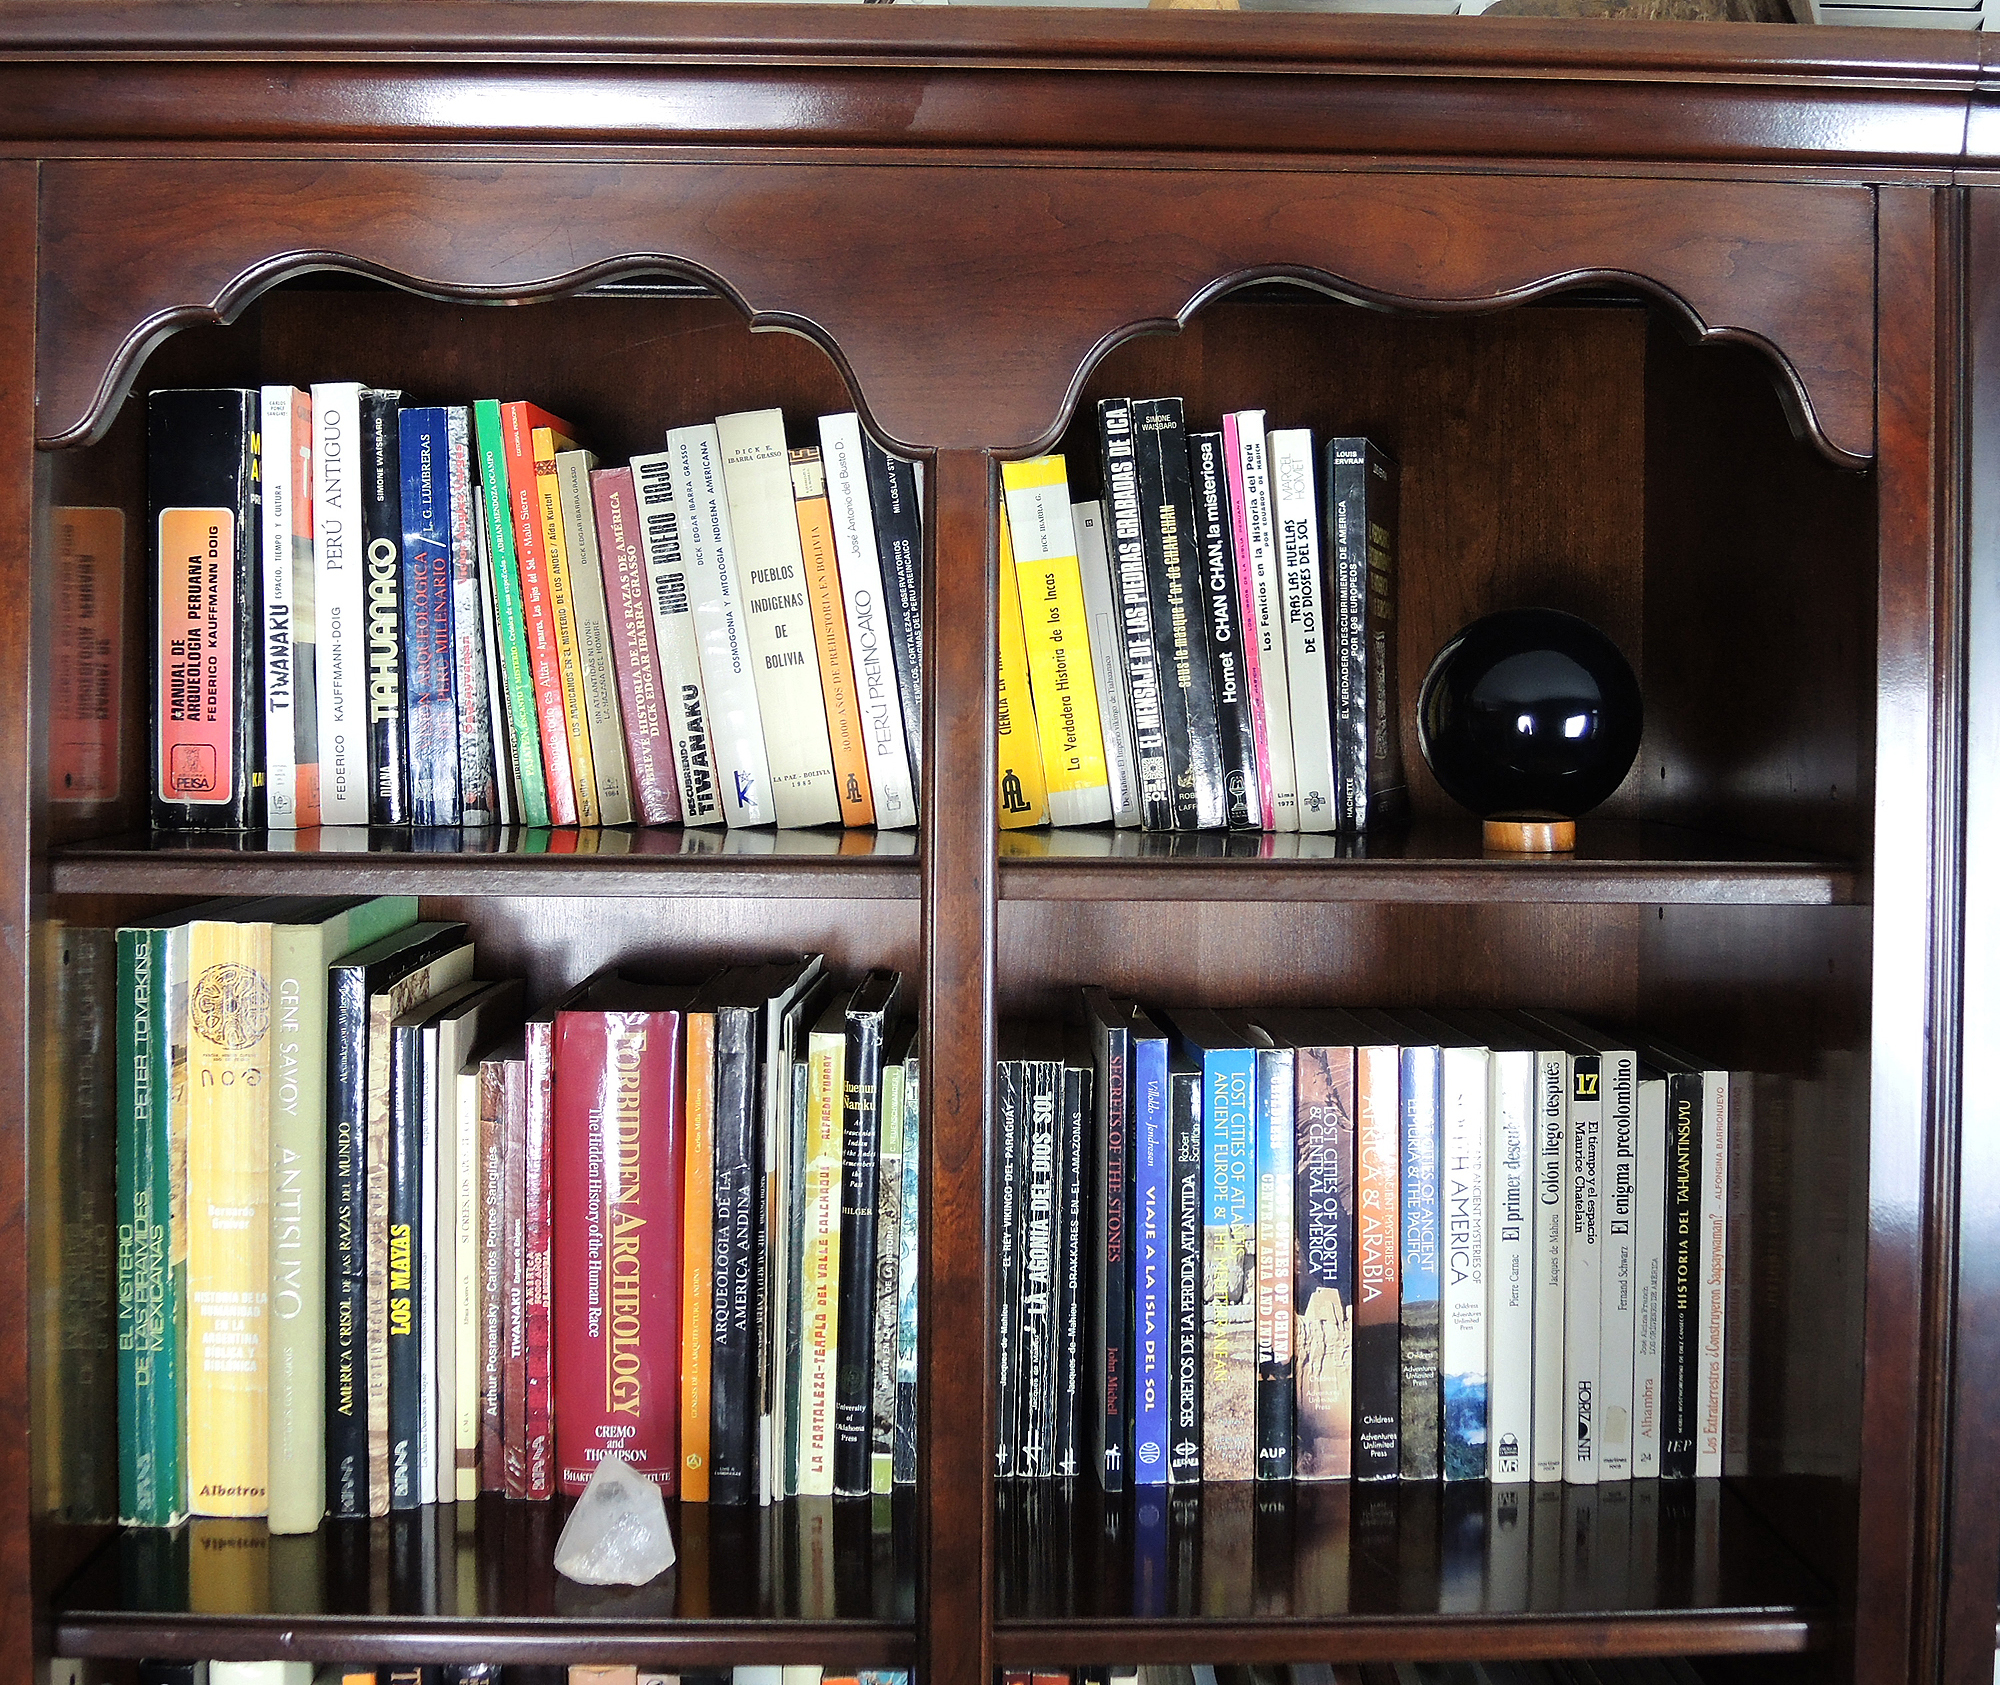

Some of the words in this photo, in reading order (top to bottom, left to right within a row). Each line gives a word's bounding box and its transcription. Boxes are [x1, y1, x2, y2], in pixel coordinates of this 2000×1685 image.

[1106, 408, 1129, 434] ICA
[324, 410, 341, 508] ANTIGUO
[1108, 439, 1130, 456] DE
[376, 468, 385, 501] SIMONE
[419, 434, 432, 504] LUMBRERAS
[640, 462, 673, 503] ROJO
[1199, 443, 1220, 521] misteriosa
[274, 485, 282, 517] CULTURA
[1037, 504, 1047, 532] IBARRA
[1111, 462, 1139, 537] GRABADAS
[207, 526, 218, 557] DOIG
[422, 522, 432, 531] L.
[609, 492, 626, 551] AMÉRICA
[648, 512, 682, 564] BOERO
[1205, 524, 1220, 538] la
[1296, 519, 1308, 540] SOL
[274, 534, 282, 561] TIEMPO
[322, 520, 343, 570] PERÚ
[617, 555, 628, 571] DE
[811, 525, 826, 572] BOLIVIA
[1040, 534, 1049, 552] DICK
[1284, 519, 1296, 567] HUELLAS
[1296, 543, 1310, 564] DEL
[751, 565, 794, 584] PUEBLOS
[818, 574, 828, 589] EN
[1117, 543, 1147, 603] PIEDRAS
[1207, 540, 1226, 591] CHAN,
[1288, 572, 1299, 590] LAS
[188, 555, 202, 620] PERUANA
[207, 564, 218, 648] KAUFFMANN
[621, 575, 633, 618] RAZAS
[656, 573, 689, 615] HUGO
[751, 593, 804, 614] INDIGENAS
[1042, 573, 1058, 600] Incas
[1299, 567, 1313, 607] DIOSES
[1349, 564, 1358, 613] EUROPEOS
[1048, 607, 1060, 623] los
[1126, 608, 1149, 633] LAS
[1211, 595, 1231, 641] CHAN
[1290, 594, 1301, 622] TRAS
[1302, 612, 1314, 632] LOS
[1350, 616, 1358, 634] LOS
[172, 640, 185, 655] DE
[368, 538, 398, 723] TIAHUANACO
[625, 621, 636, 646] LAS
[775, 625, 788, 639] DE
[822, 592, 838, 667] PREHISTORIA
[854, 590, 884, 698] PREINCAICO
[1050, 627, 1063, 642] de
[1130, 639, 1151, 657] DE
[1303, 638, 1315, 653] DE
[1350, 638, 1358, 656] POR
[188, 628, 202, 721] ARQUEOLOGIA
[269, 604, 289, 713] TIWANAKU
[331, 607, 343, 721] KAUFFMANN-DOIG
[629, 649, 640, 666] DE
[765, 651, 804, 670] BOLIVIA
[831, 668, 843, 684] DE
[1053, 648, 1069, 691] Historia
[1220, 651, 1237, 703] Homet
[171, 663, 185, 721] MANUAL
[207, 656, 217, 722] FEDERICO
[632, 669, 649, 735] HISTORIA
[833, 687, 846, 715] AÑOS
[1131, 661, 1159, 728] MENSAJE
[841, 718, 853, 752] 30.000
[867, 702, 893, 755] PERÚ
[1056, 695, 1078, 751] Verdadera
[1141, 732, 1162, 748] EL
[334, 735, 346, 800] FEDERICO
[640, 739, 657, 782] BREVE
[682, 684, 714, 815] TIWANAKU
[1065, 758, 1081, 770] La
[379, 766, 392, 796] DIANA
[680, 740, 697, 816] DESCUBRIENDO
[1346, 778, 1354, 817] HACHETTE
[135, 944, 149, 1042] TOMPKINS
[279, 979, 300, 1032] GENE
[135, 1055, 149, 1118] PETER
[279, 1043, 299, 1116] SAVOY
[1109, 1056, 1122, 1125] SECRETS
[1545, 1062, 1565, 1117] después
[1576, 1074, 1598, 1095] 17
[588, 1108, 601, 1130] The
[1613, 1059, 1634, 1158] precolombino
[1716, 1087, 1724, 1149] BARRIONUEVO
[588, 1133, 602, 1177] Hidden
[1108, 1130, 1121, 1154] OF
[1542, 1121, 1563, 1156] llegó
[1677, 1100, 1691, 1204] TAHUANTINSUYU
[718, 1170, 731, 1192] LA
[1108, 1159, 1121, 1193] THE
[1541, 1163, 1561, 1205] Colón
[1614, 1163, 1634, 1215] enigma
[1715, 1152, 1724, 1200] ALFONSINA
[586, 1179, 603, 1223] History
[717, 1197, 730, 1219] DE
[735, 1185, 750, 1250] ANDINA
[1145, 1186, 1155, 1240] VIAJE
[1181, 1174, 1195, 1254] ATLANTIDA
[273, 1143, 301, 1319] ANTISUYO
[486, 1209, 498, 1247] Ponce
[588, 1226, 603, 1238] of
[1108, 1198, 1121, 1262] STONES
[1611, 1219, 1629, 1235] El
[1679, 1210, 1689, 1234] DEL
[391, 1224, 411, 1291] MAYAS
[588, 1240, 602, 1258] the
[1145, 1245, 1155, 1260] A
[1510, 1254, 1520, 1281] Carnac
[1619, 1247, 1629, 1277] Schwarz
[119, 1223, 133, 1319] MISTERIO
[485, 1252, 498, 1292] Carlos
[588, 1260, 602, 1304] Human
[715, 1227, 732, 1345] ARQUEOLOGIA
[1145, 1265, 1155, 1289] LA
[1181, 1256, 1195, 1312] PERDIDA
[1676, 1240, 1689, 1309] HISTORIA
[611, 1209, 646, 1417] ARCHEOLOGY
[735, 1257, 750, 1331] AMERICA
[1509, 1283, 1520, 1307] Pierre
[1618, 1281, 1629, 1310] Fernand
[391, 1297, 410, 1335] LOS
[511, 1288, 521, 1358] TIWANAKU
[588, 1309, 601, 1337] Race
[1145, 1295, 1155, 1335] ISLA
[1181, 1315, 1194, 1331] LA
[120, 1326, 133, 1349] EL
[486, 1304, 502, 1372] Posnansky
[1145, 1341, 1155, 1373] DEL
[1181, 1335, 1194, 1354] DE
[1107, 1347, 1118, 1371] John
[486, 1376, 498, 1416] Arthur
[1107, 1376, 1118, 1414] Michell
[1145, 1379, 1155, 1412] SOL
[1181, 1358, 1194, 1427] SECRETOS
[1703, 1361, 1720, 1432] Extraterrestres
[595, 1426, 636, 1438] CREMO
[1703, 1437, 1718, 1454] Los
[200, 1485, 266, 1498] Albatros
